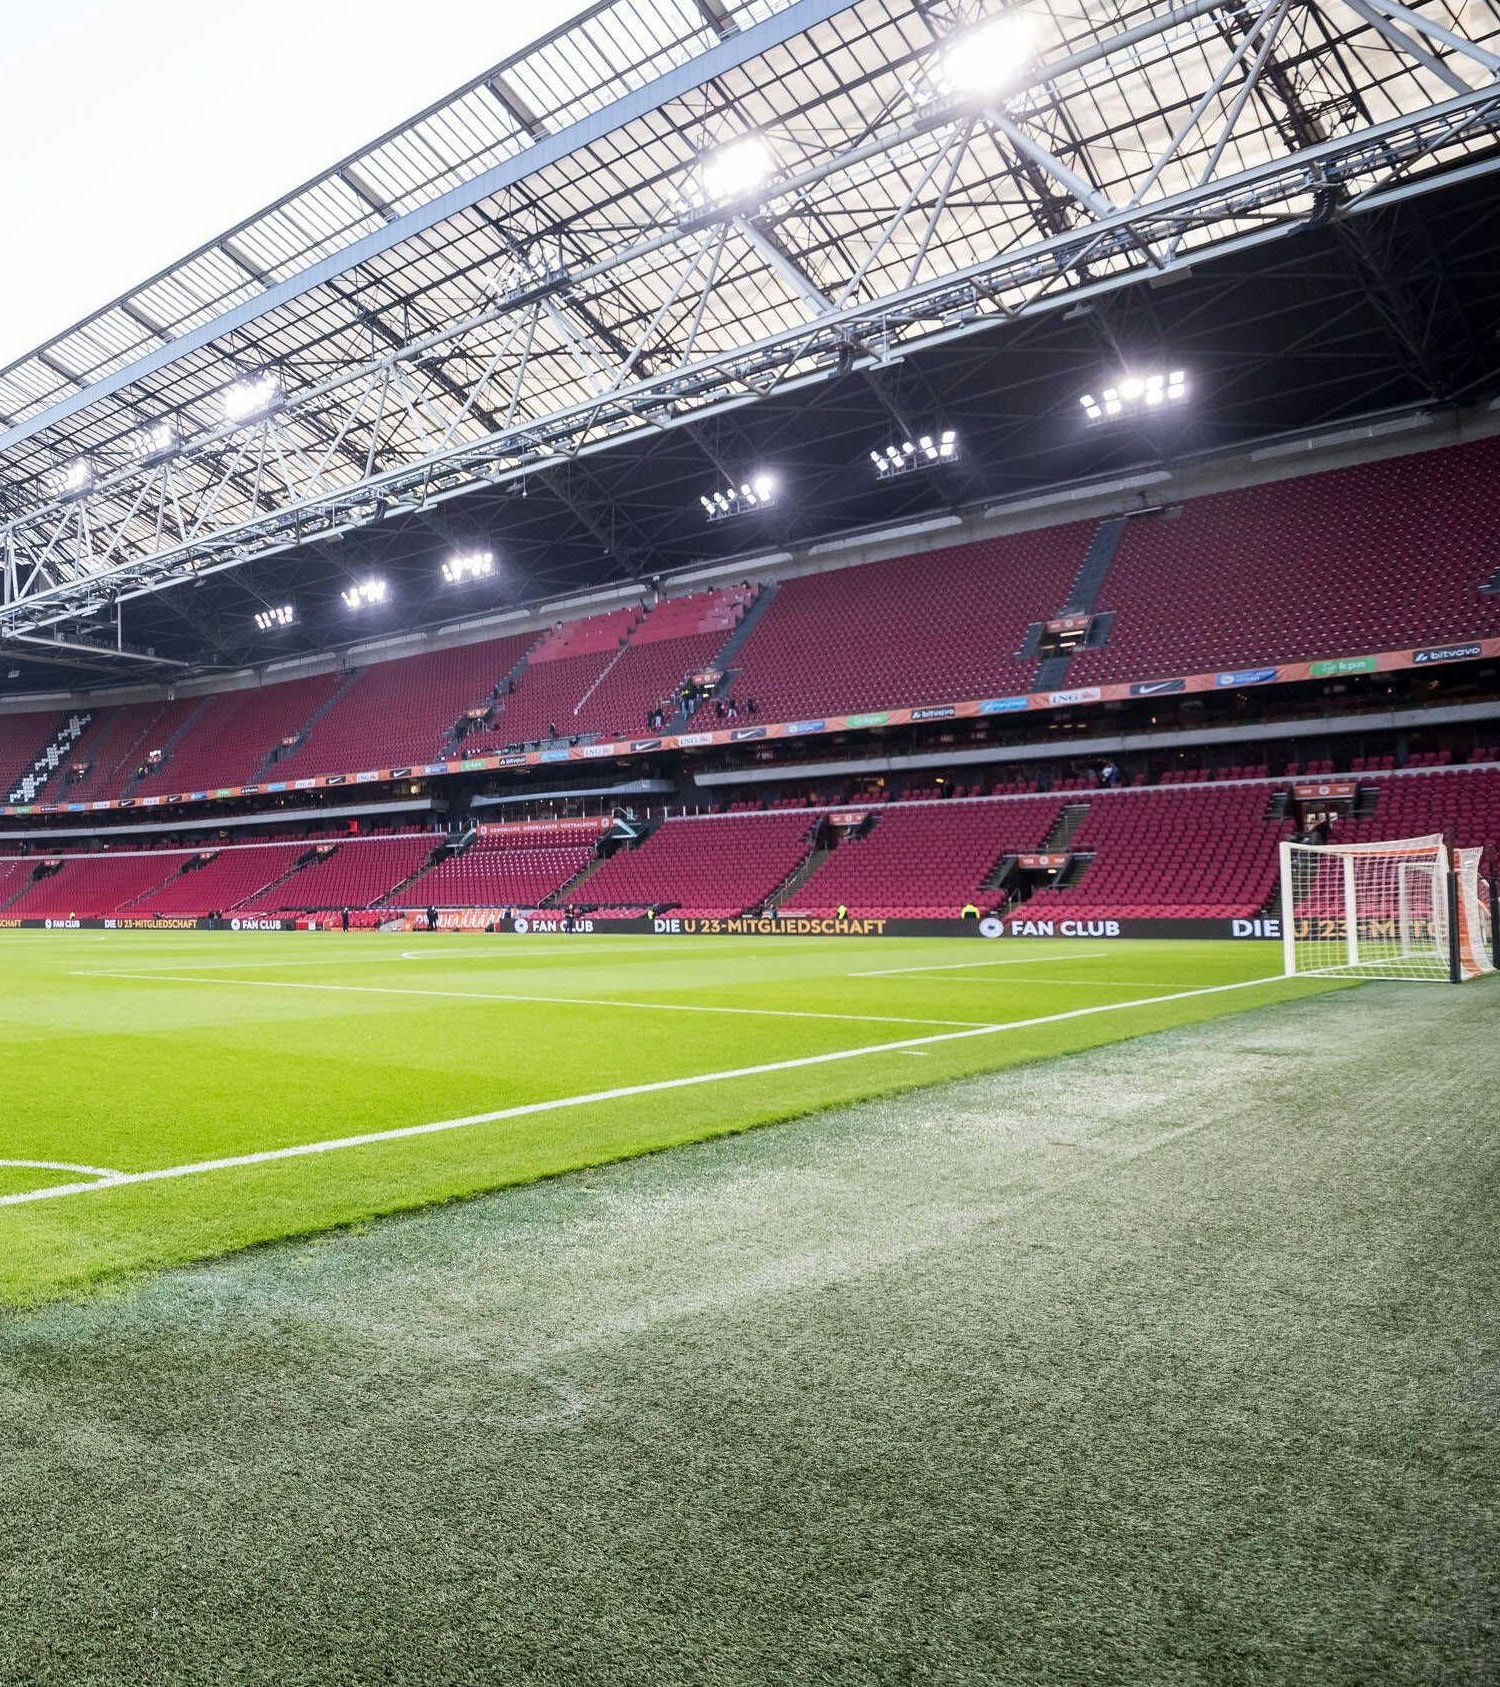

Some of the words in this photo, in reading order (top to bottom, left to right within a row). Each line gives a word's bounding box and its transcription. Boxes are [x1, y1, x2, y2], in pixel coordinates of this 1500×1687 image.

[1429, 647, 1481, 661] bitvavo
[1338, 660, 1366, 671] kpn
[1052, 692, 1079, 704] ING
[921, 708, 955, 718] bitvavo
[53, 919, 65, 930] FAN
[66, 919, 81, 930] CLUB
[104, 919, 117, 929] DIE
[117, 919, 124, 929] U
[124, 919, 197, 929] 23-MITGLIEDSCHAFT
[242, 920, 258, 930] FAN
[259, 920, 281, 930] CLUB
[532, 920, 556, 932] FAN
[654, 919, 680, 933] DIE
[684, 920, 696, 934] U
[700, 919, 886, 935] 23-MITGLIEDSCHAFT
[1011, 920, 1054, 936] FAN
[1059, 920, 1120, 937] CLUB
[1232, 919, 1281, 938] DIE
